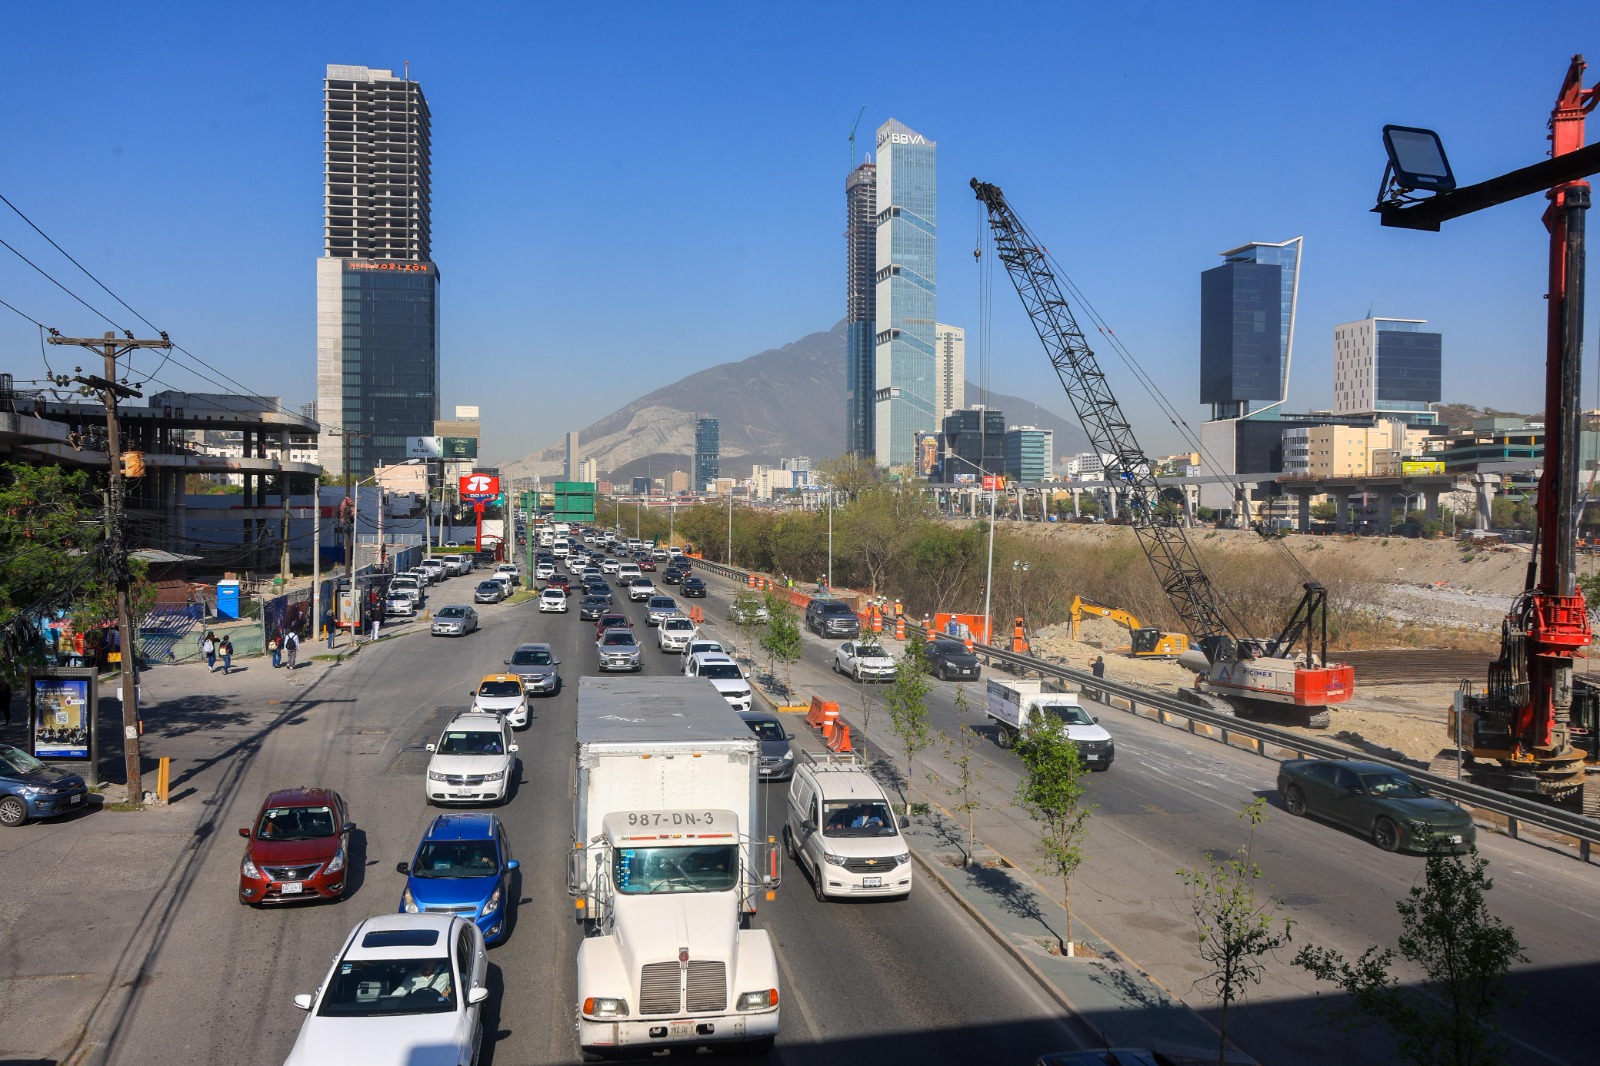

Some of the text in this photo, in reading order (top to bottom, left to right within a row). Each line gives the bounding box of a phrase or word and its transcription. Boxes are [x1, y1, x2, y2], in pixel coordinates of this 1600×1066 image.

[891, 133, 926, 145] BBVA
[1242, 668, 1273, 678] PICIMEX
[628, 812, 714, 827] 987-DN-3
